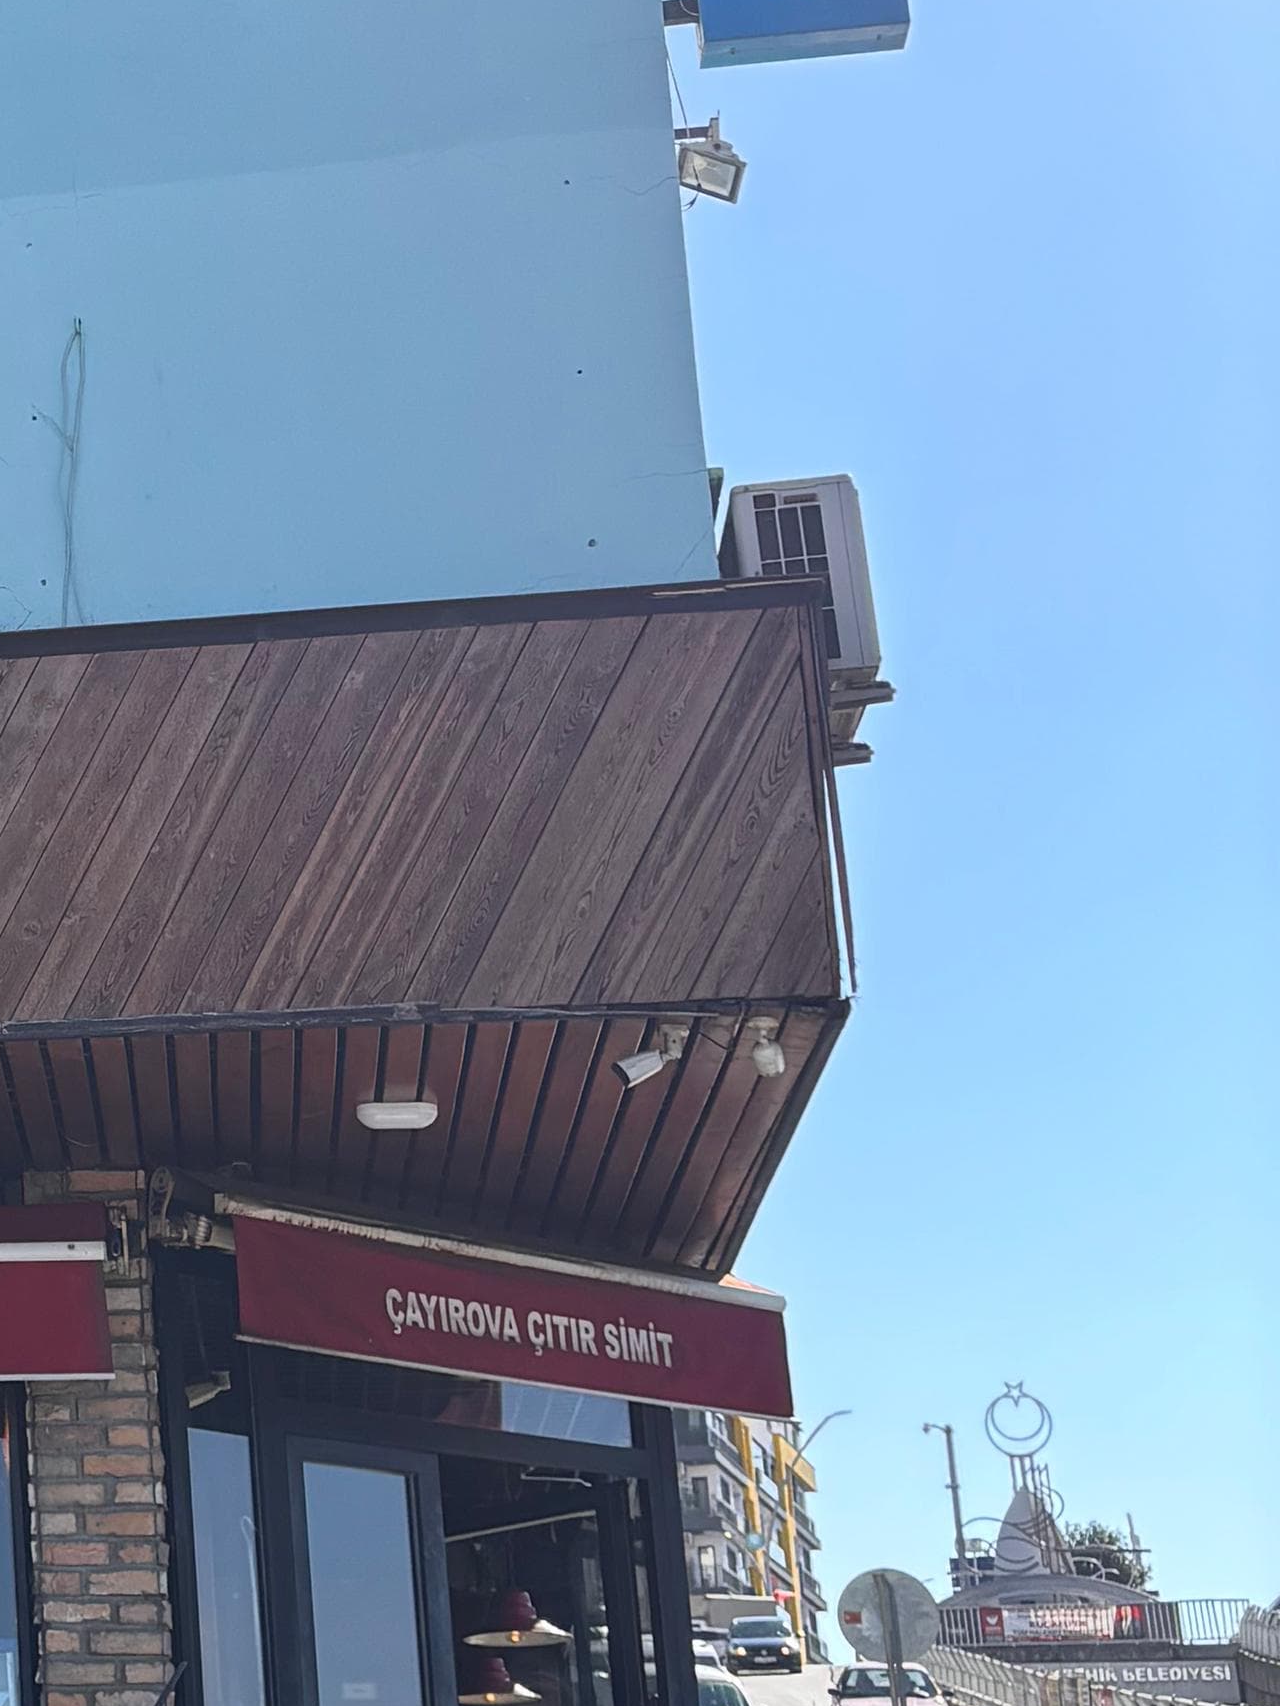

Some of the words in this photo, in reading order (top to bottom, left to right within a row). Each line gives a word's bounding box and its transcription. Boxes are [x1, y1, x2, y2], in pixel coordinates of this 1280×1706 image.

[385, 1288, 521, 1345] ÇAYIROVA
[526, 1310, 599, 1357] ÇITIR
[604, 1317, 673, 1368] SİMİT
